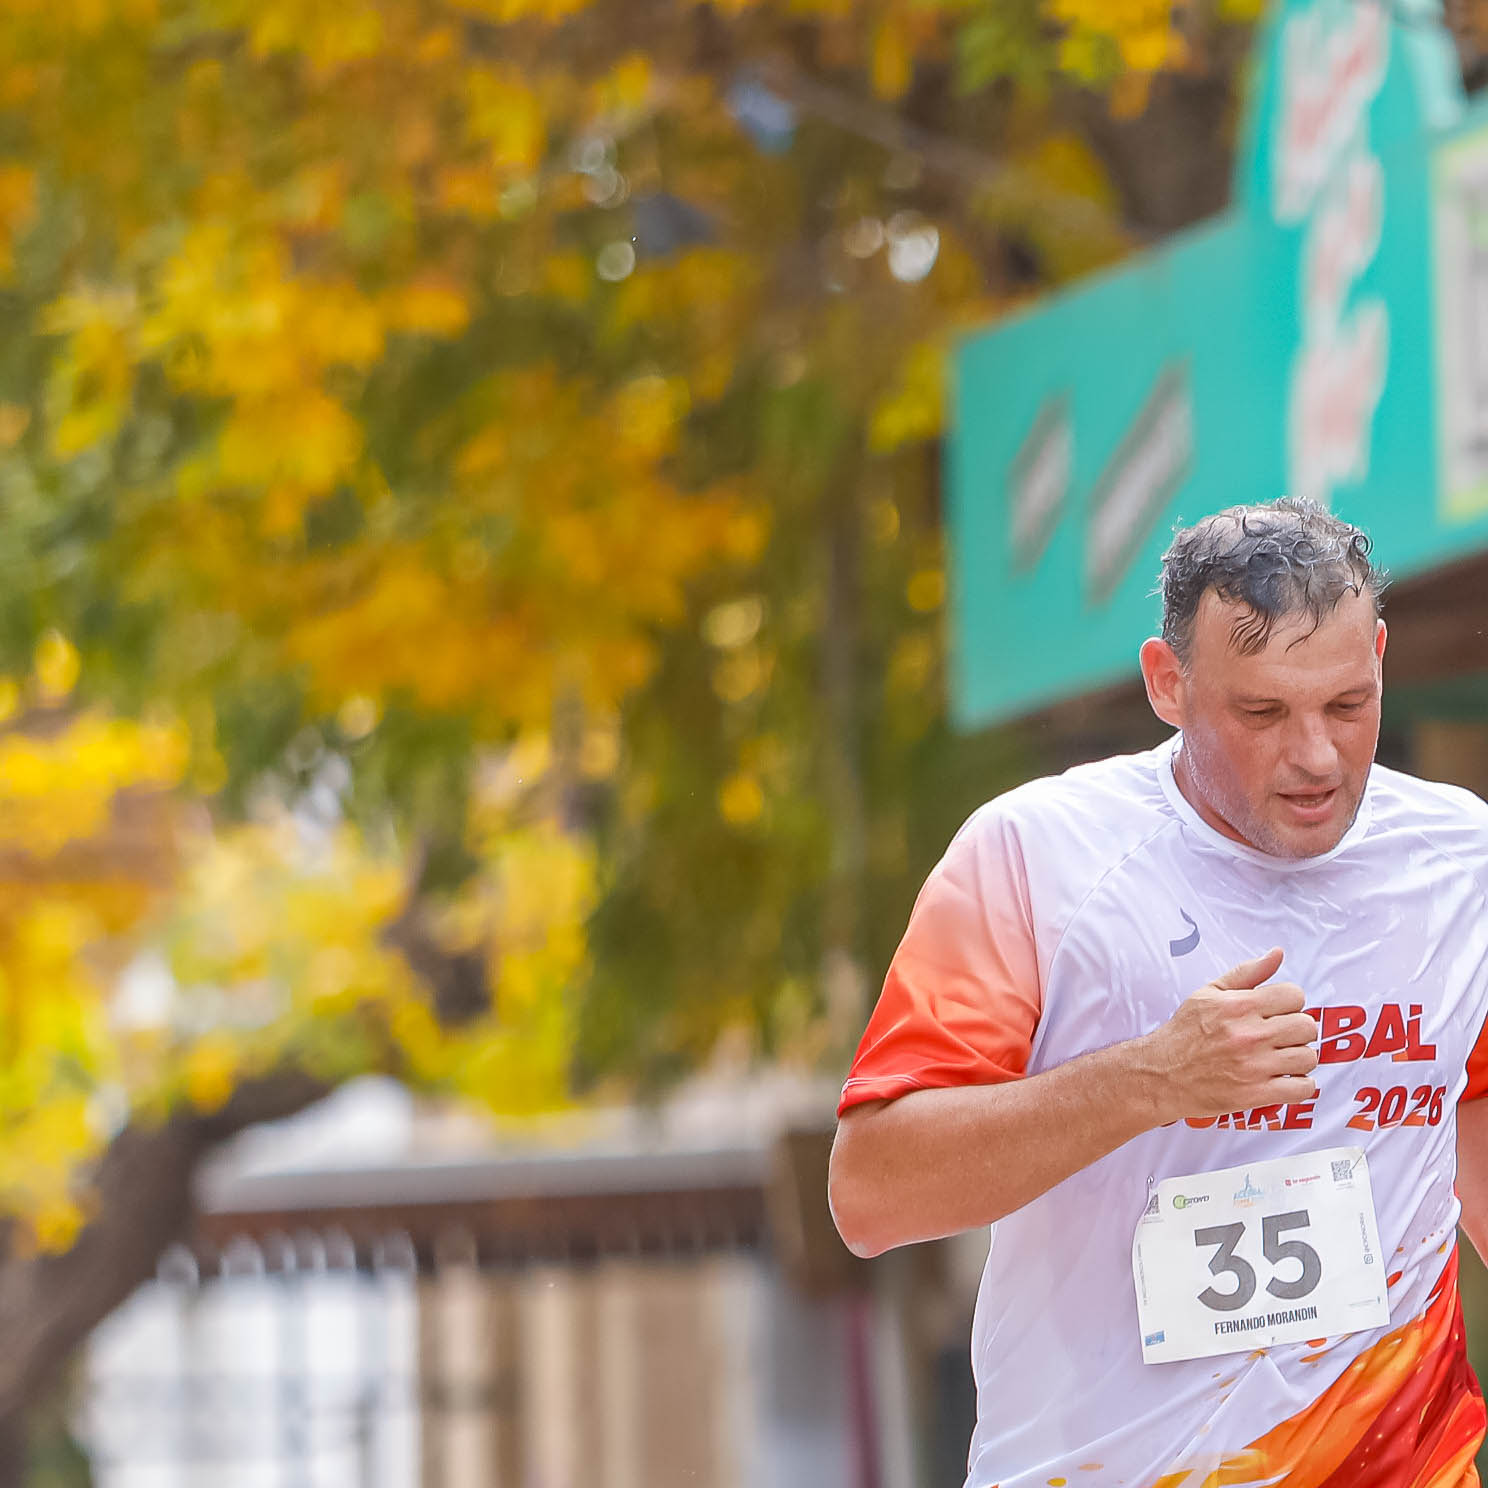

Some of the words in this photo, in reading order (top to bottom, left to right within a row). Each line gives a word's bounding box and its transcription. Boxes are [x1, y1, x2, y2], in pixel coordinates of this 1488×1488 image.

[1345, 1084, 1447, 1132] 2026
[1194, 1209, 1322, 1312] 35
[1214, 1315, 1266, 1336] FERNANDO
[1266, 1305, 1318, 1327] MORANDIN
